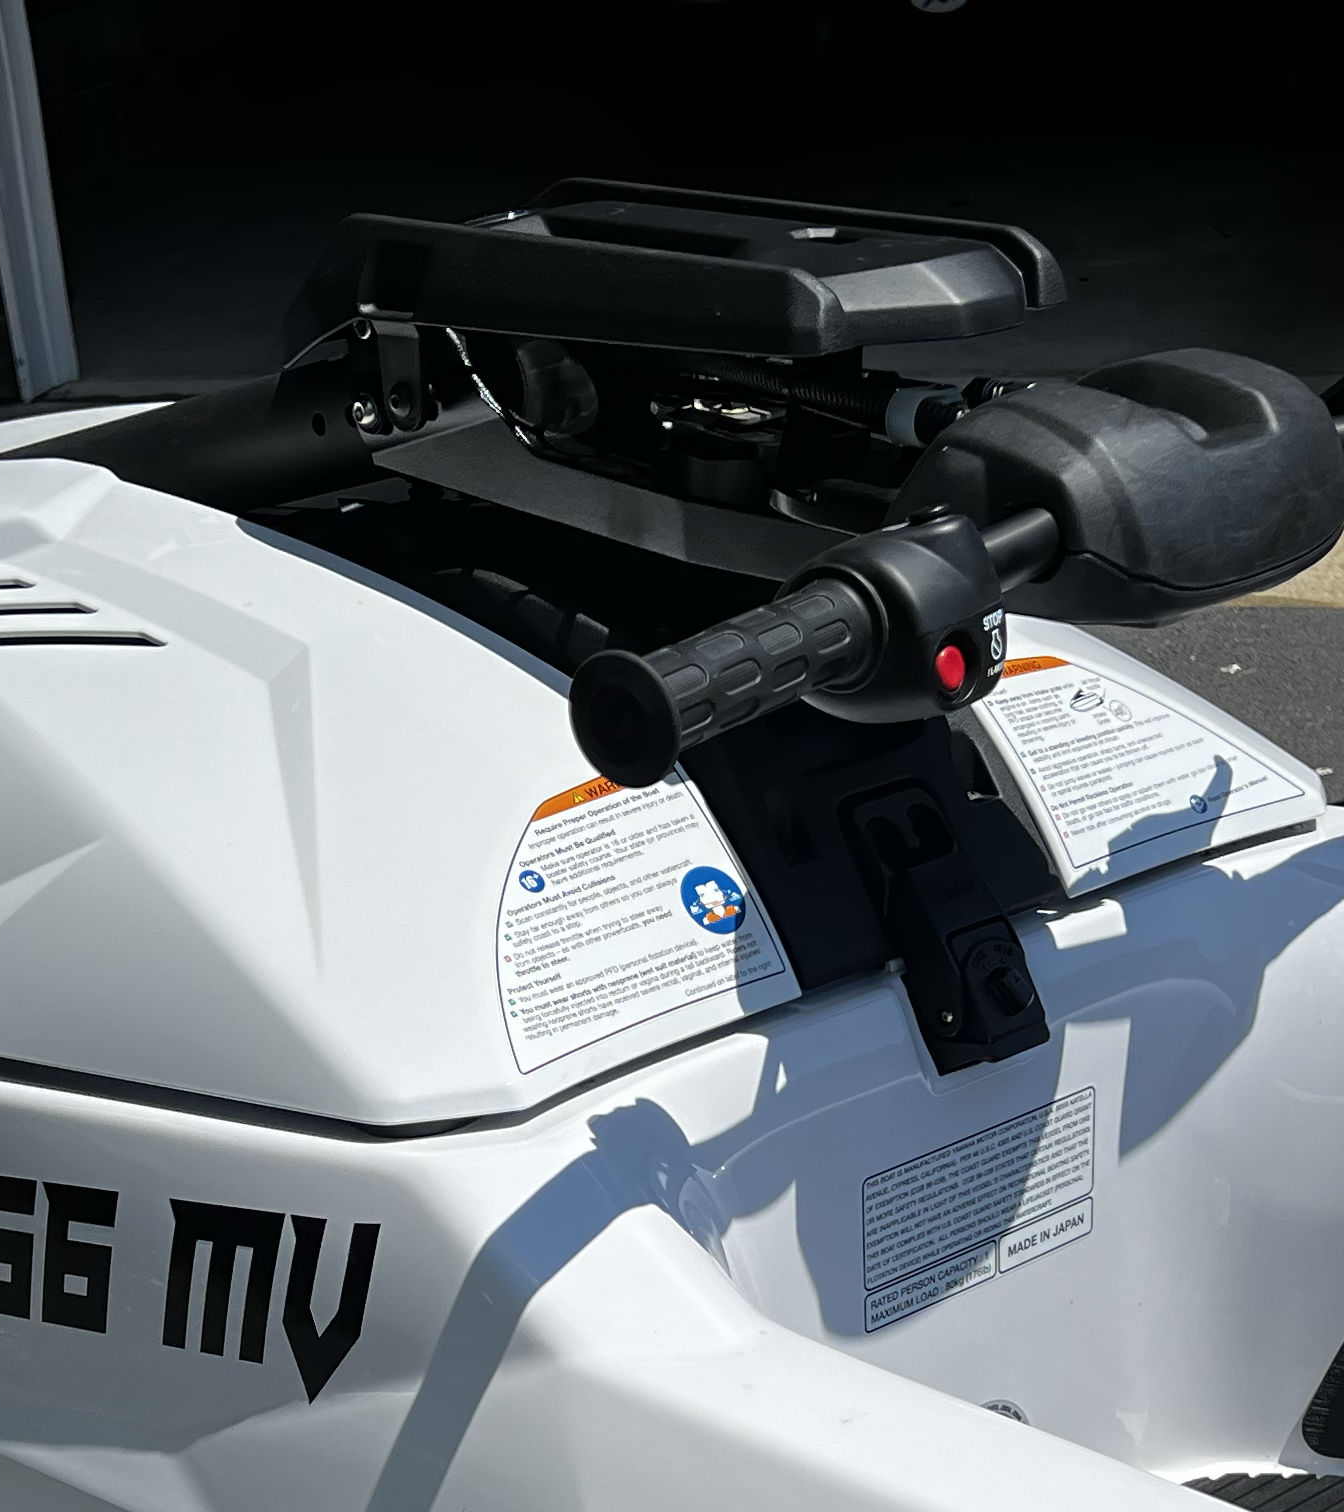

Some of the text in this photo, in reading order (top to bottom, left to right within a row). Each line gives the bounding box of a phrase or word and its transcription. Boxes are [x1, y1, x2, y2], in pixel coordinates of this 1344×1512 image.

[982, 607, 1004, 632] STOP
[534, 822, 563, 838] Require
[562, 813, 587, 828] Proper
[587, 801, 623, 819] Operation
[519, 829, 616, 870] Operators Must Be Qualified
[507, 875, 616, 919] Operators Must Avoid Collisions
[507, 973, 562, 996] Protect Yourself
[1008, 1213, 1084, 1257] MADE IN JAPAN
[161, 1197, 382, 1406] MV
[871, 1291, 898, 1310] RATED
[901, 1274, 936, 1297] PERSON
[938, 1256, 977, 1281] CAPACITY
[871, 1298, 913, 1324] MAXIMUM
[916, 1287, 938, 1304] LOAD
